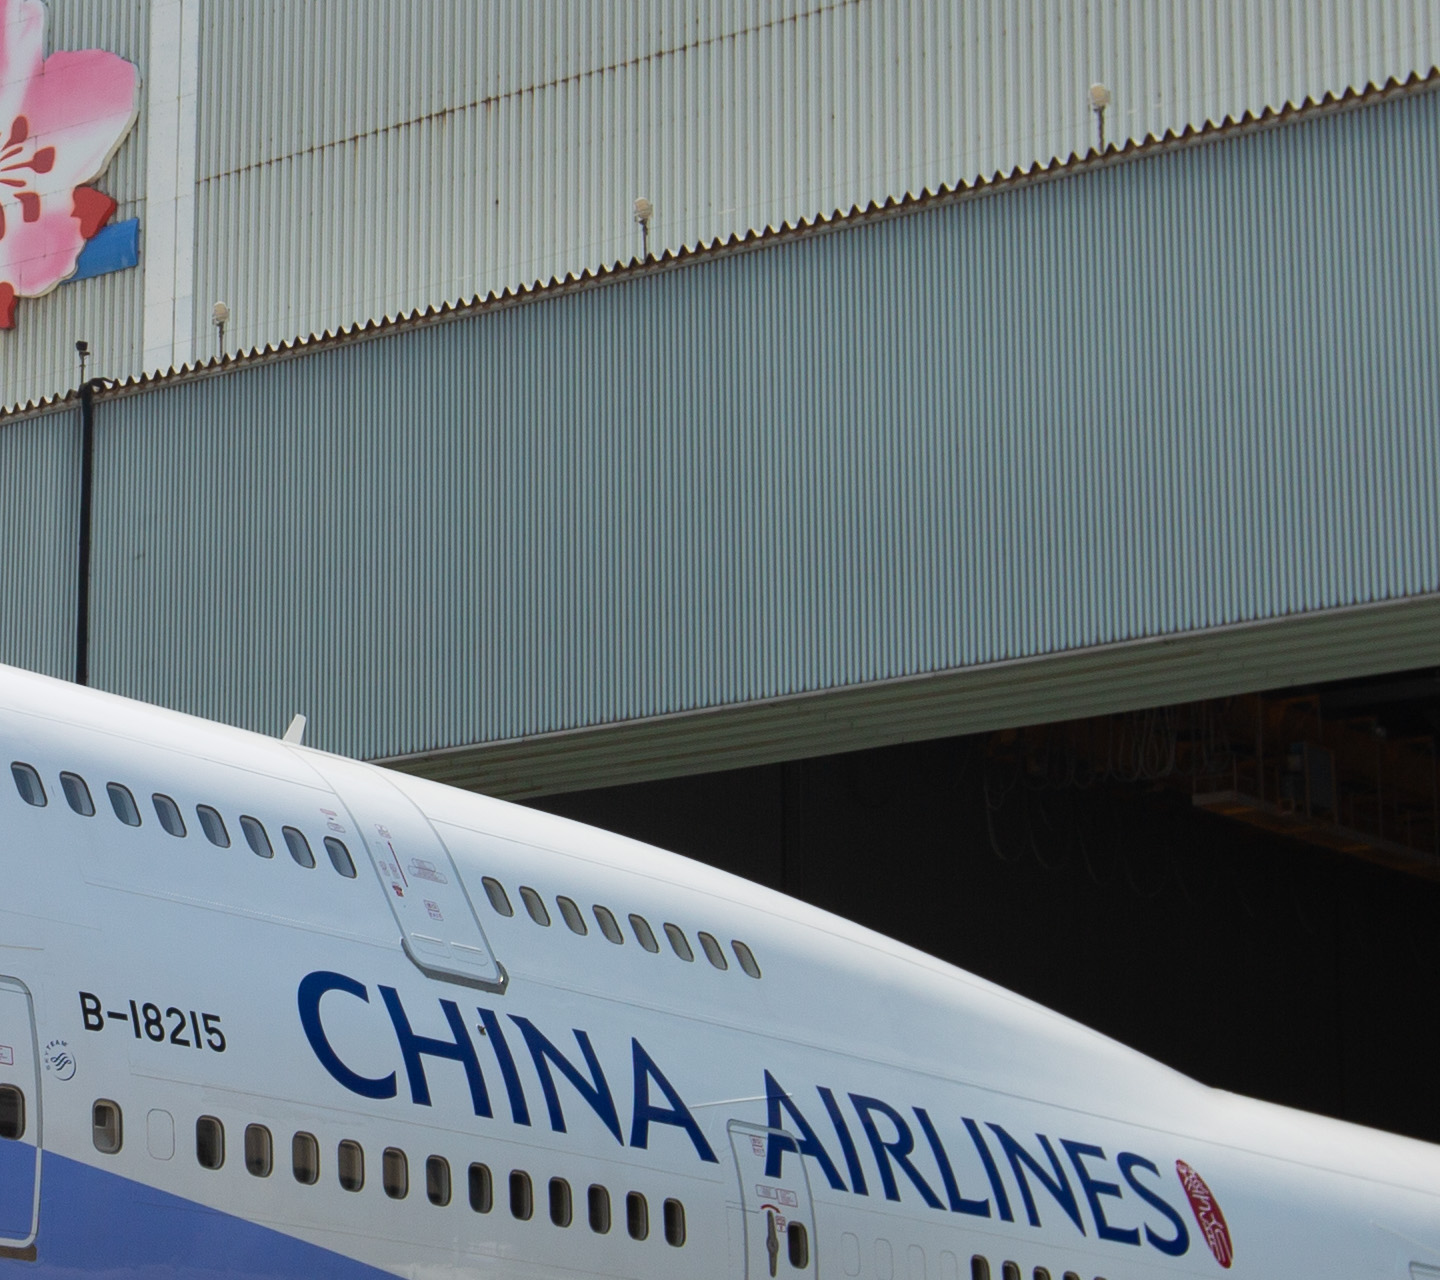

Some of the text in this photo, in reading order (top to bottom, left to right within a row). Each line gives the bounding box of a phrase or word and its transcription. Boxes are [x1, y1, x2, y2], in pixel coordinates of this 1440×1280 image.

[78, 990, 227, 1053] B-18215
[297, 970, 1190, 1257] CHINA AIRLINES
